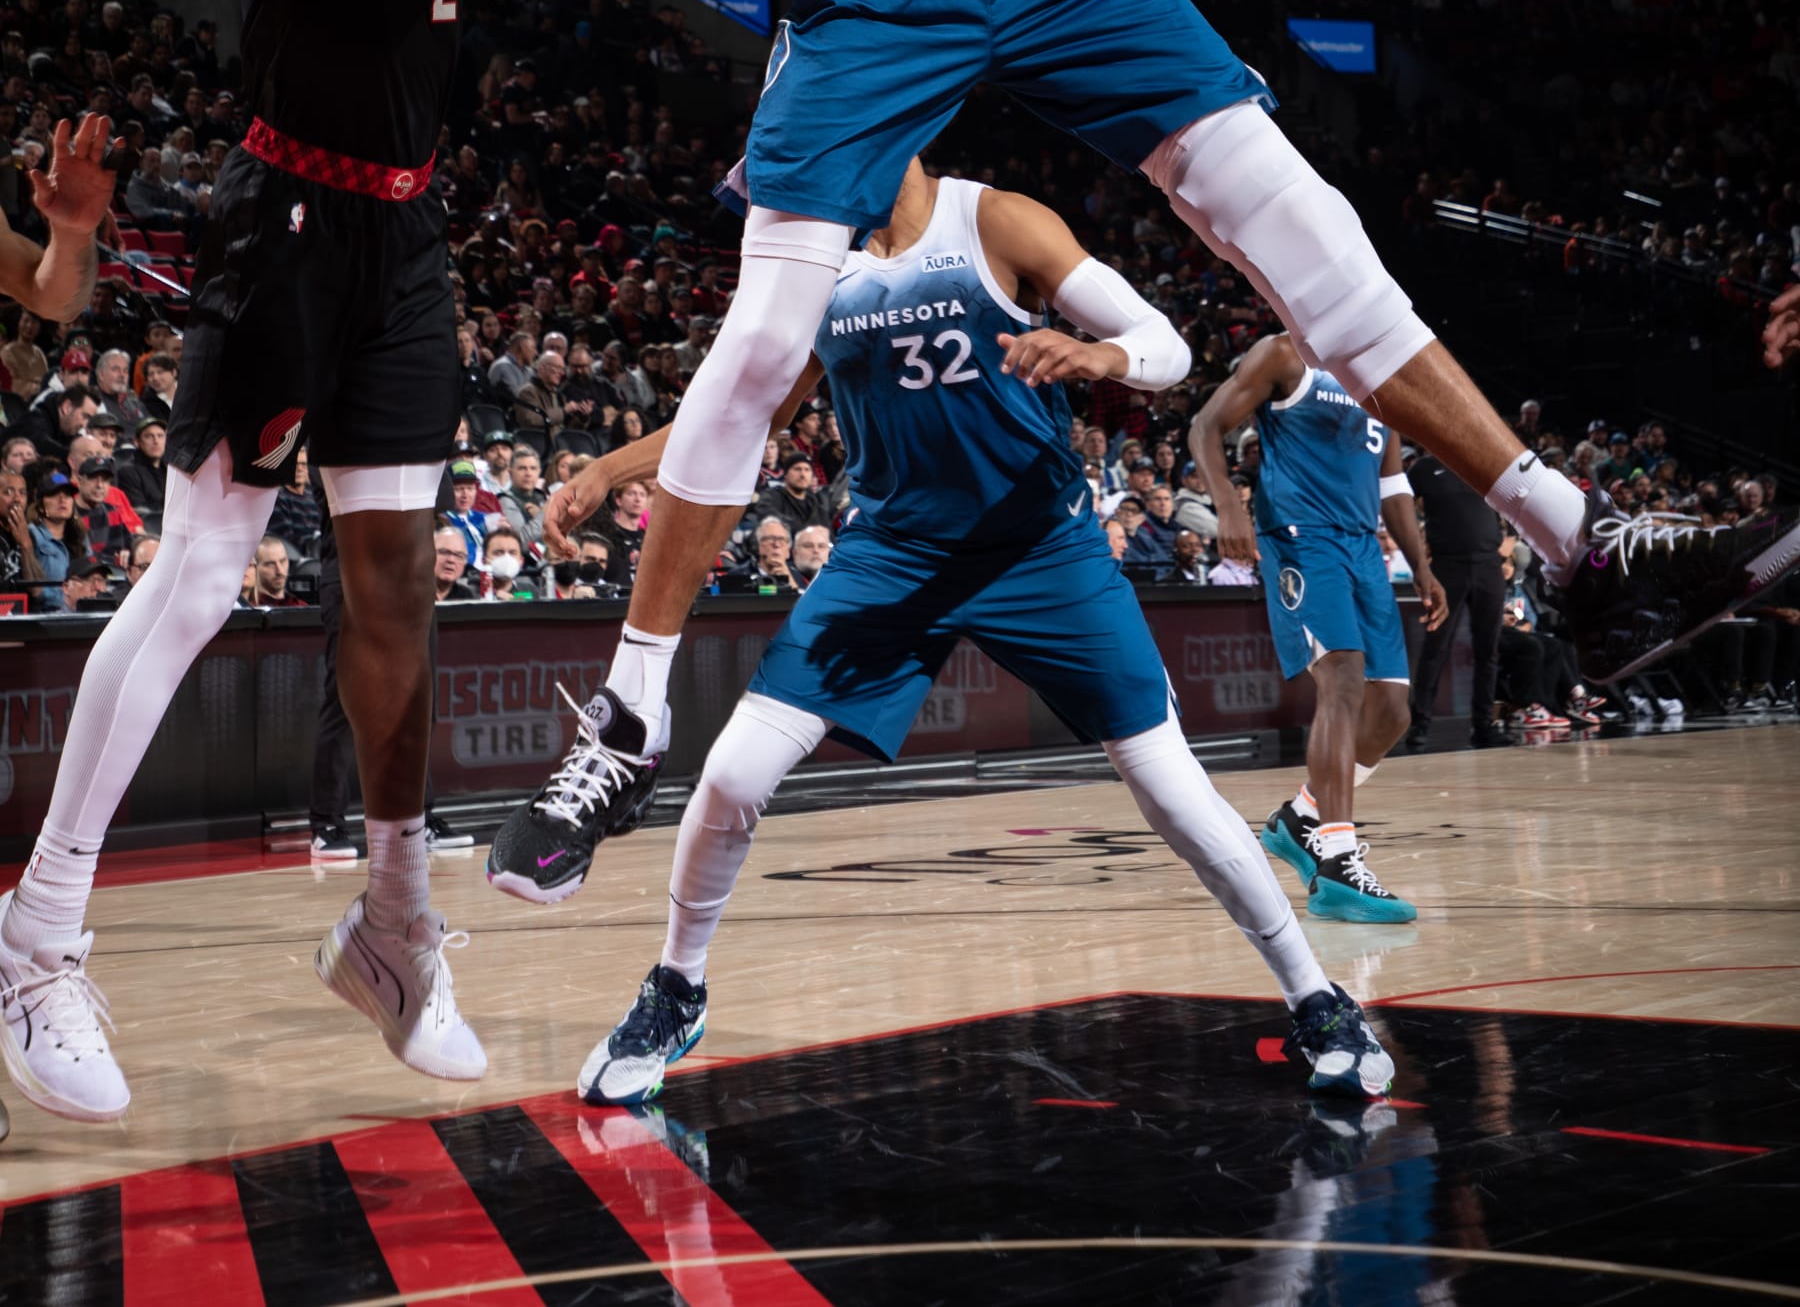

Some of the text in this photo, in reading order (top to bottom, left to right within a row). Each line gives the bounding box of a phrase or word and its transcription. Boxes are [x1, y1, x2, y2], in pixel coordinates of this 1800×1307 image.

[830, 298, 967, 337] MINNESOTA
[890, 329, 980, 390] 32
[1365, 416, 1384, 455] 5
[436, 660, 608, 719] ISCOUNT
[1222, 680, 1273, 706] TIRE
[921, 698, 956, 724] RE
[465, 723, 550, 758] TIRE
